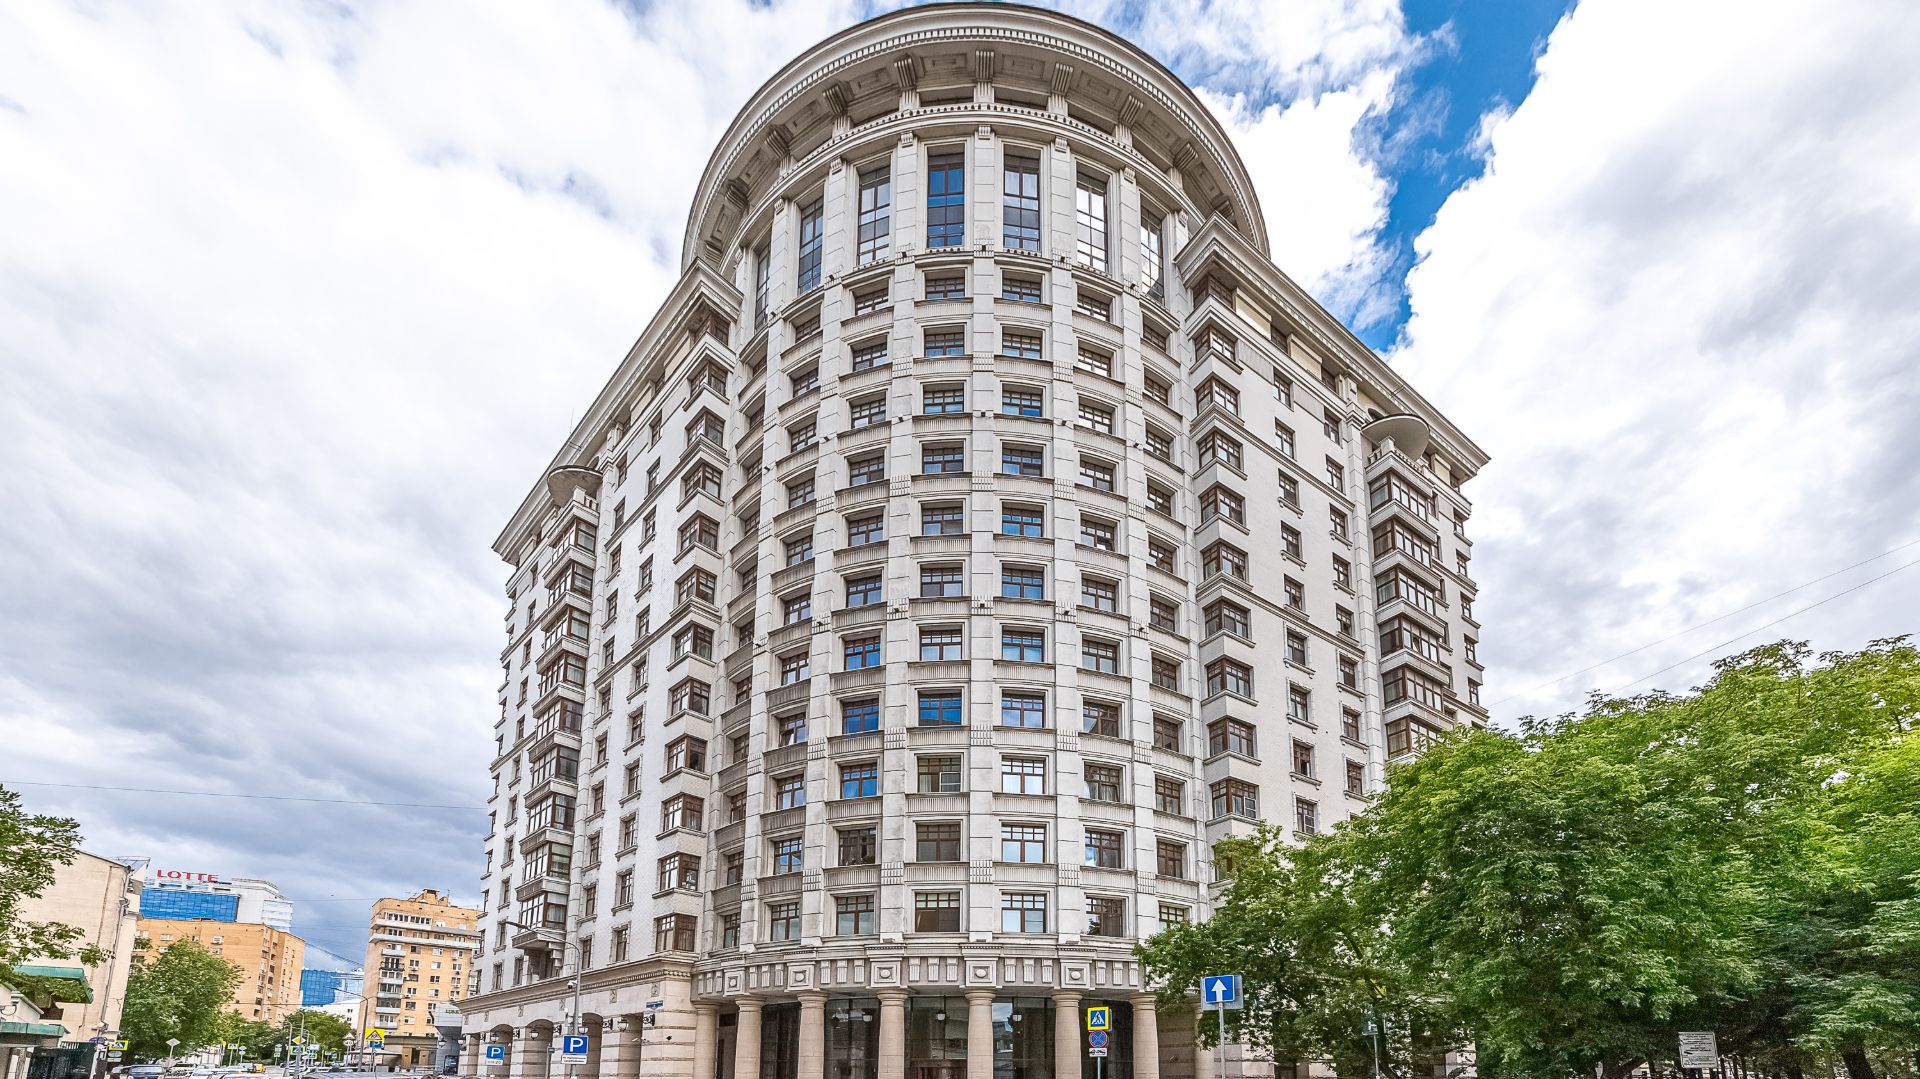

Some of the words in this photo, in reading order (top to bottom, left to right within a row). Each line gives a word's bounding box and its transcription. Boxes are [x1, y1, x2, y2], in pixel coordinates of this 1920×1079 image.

[157, 869, 219, 882] LOTTE
[570, 1037, 584, 1052] P
[491, 1047, 501, 1057] P
